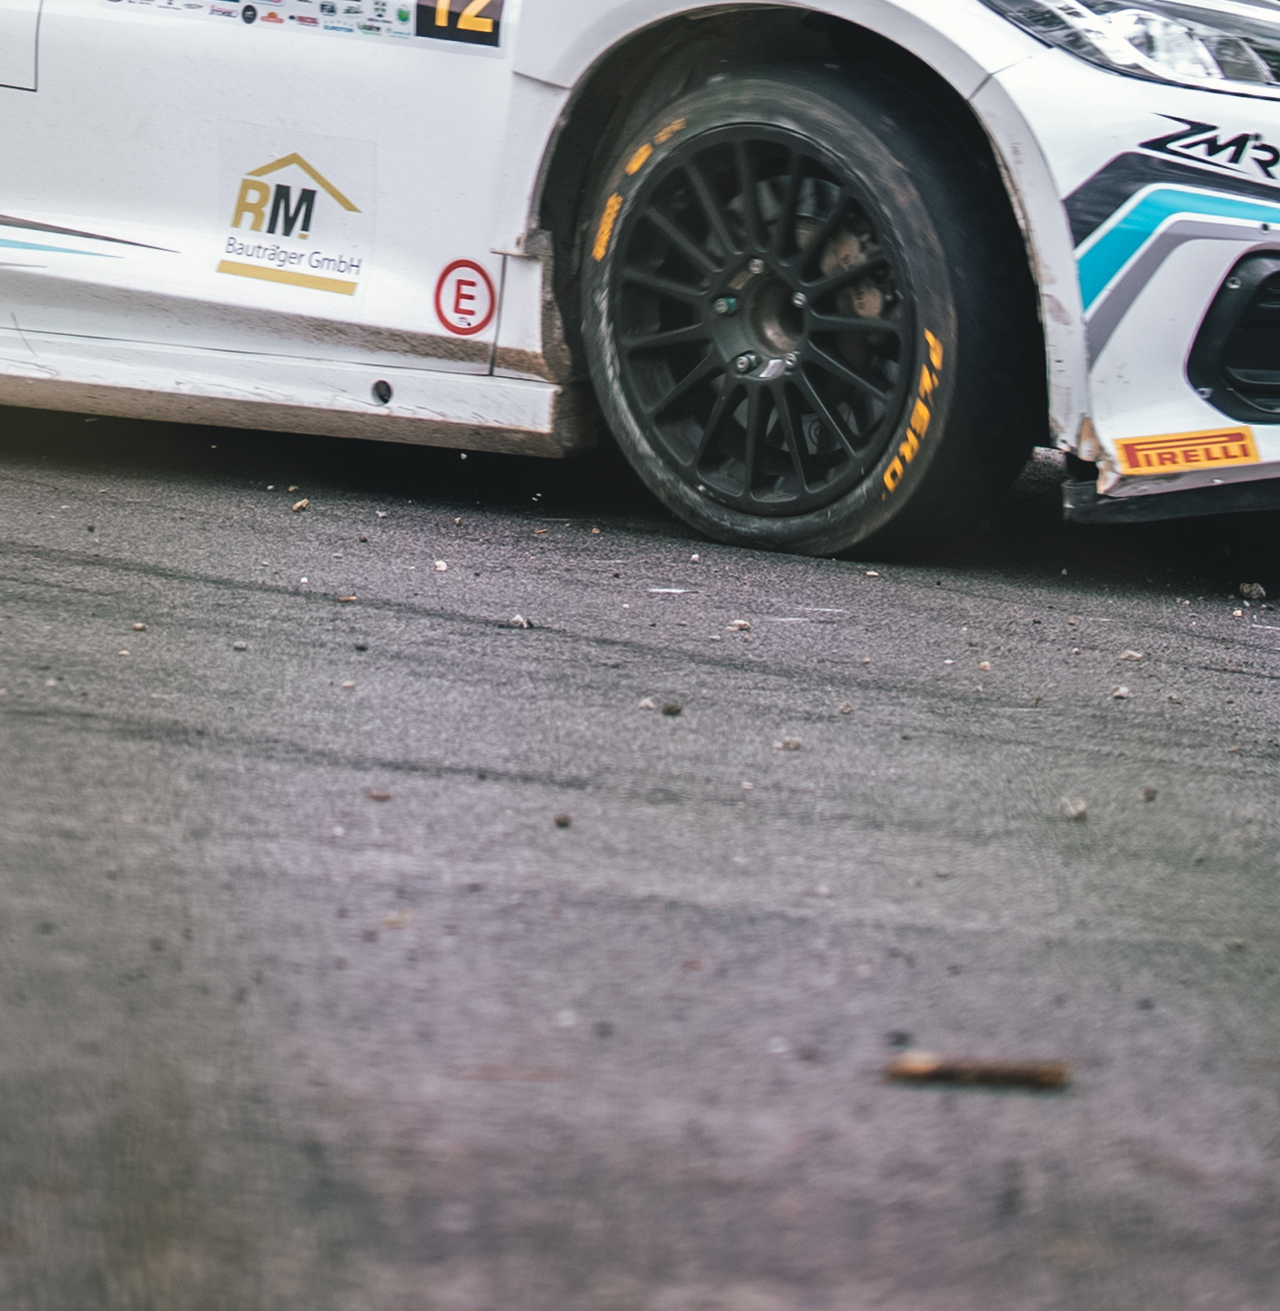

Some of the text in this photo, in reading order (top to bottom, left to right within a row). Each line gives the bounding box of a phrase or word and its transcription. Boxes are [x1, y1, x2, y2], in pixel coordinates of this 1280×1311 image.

[224, 236, 362, 276] Bauträger GmbH
[453, 278, 477, 317] E
[1122, 432, 1251, 469] PIRELLI
